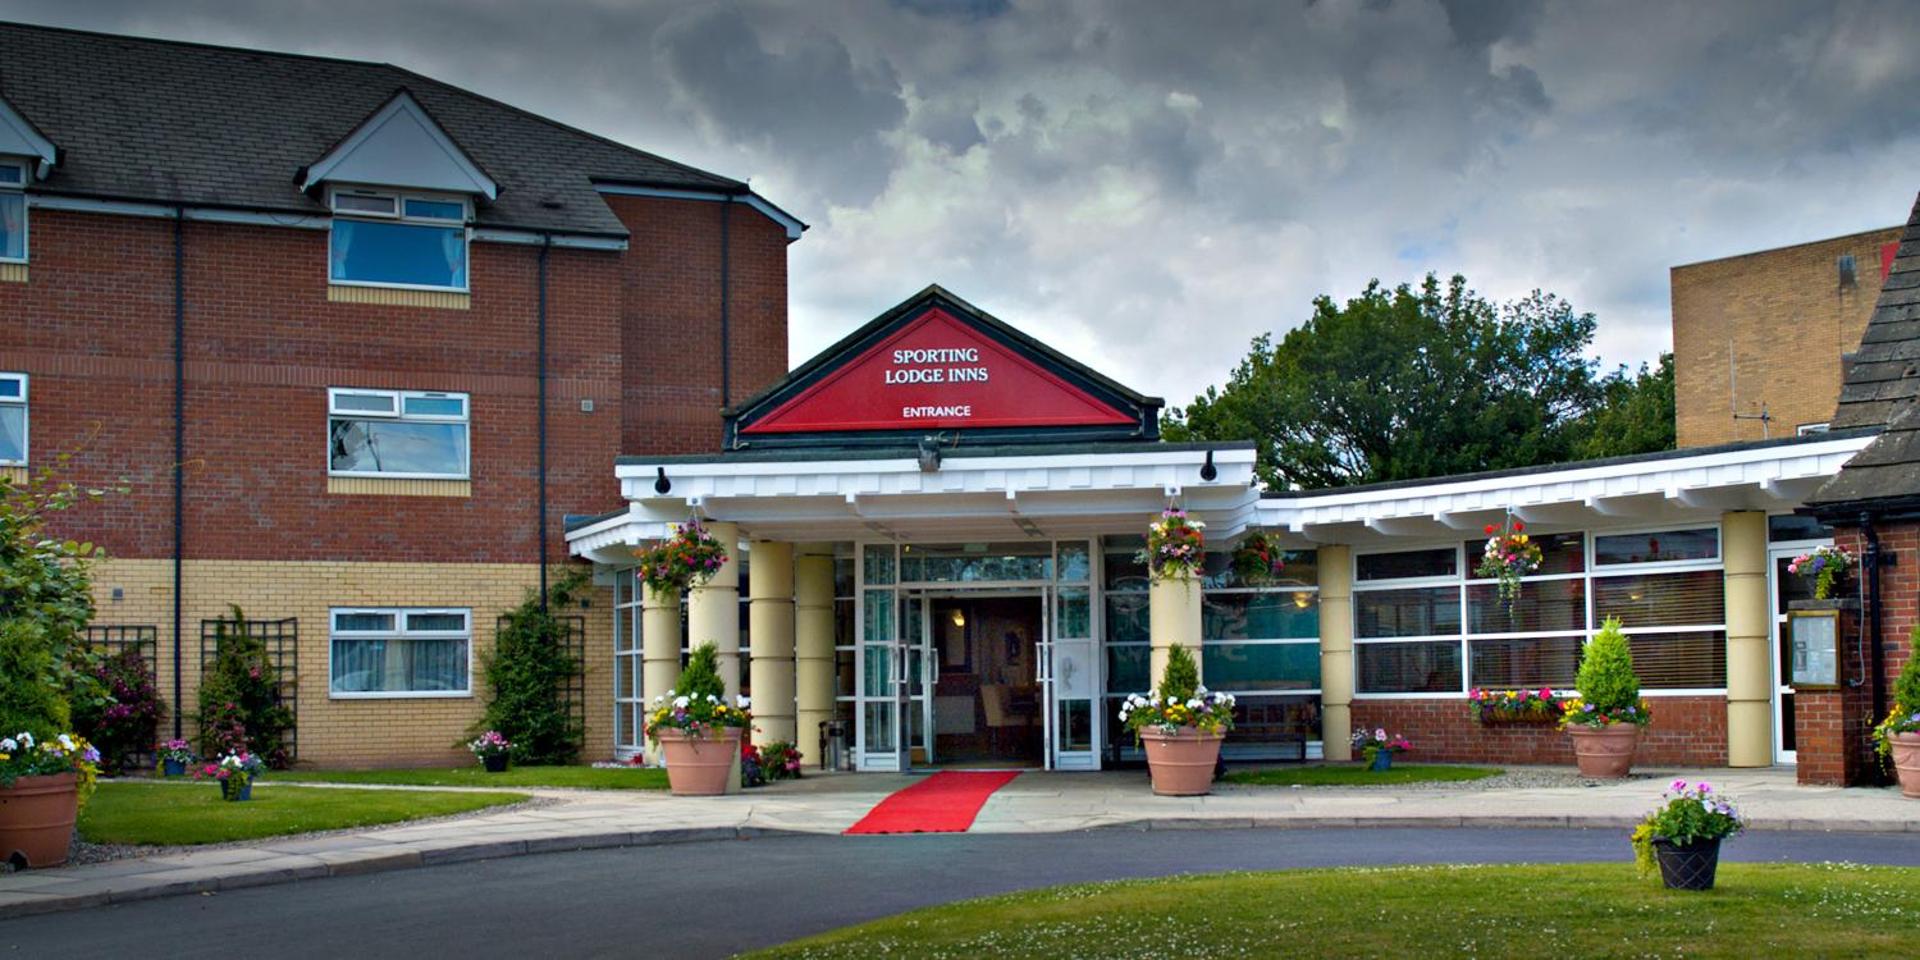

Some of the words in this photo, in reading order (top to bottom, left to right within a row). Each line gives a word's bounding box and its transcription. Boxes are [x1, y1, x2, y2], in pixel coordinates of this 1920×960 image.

[893, 348, 979, 364] SPORTING
[885, 369, 945, 384] LODGE
[948, 367, 988, 382] INNS
[902, 405, 971, 418] ENTRANCE
